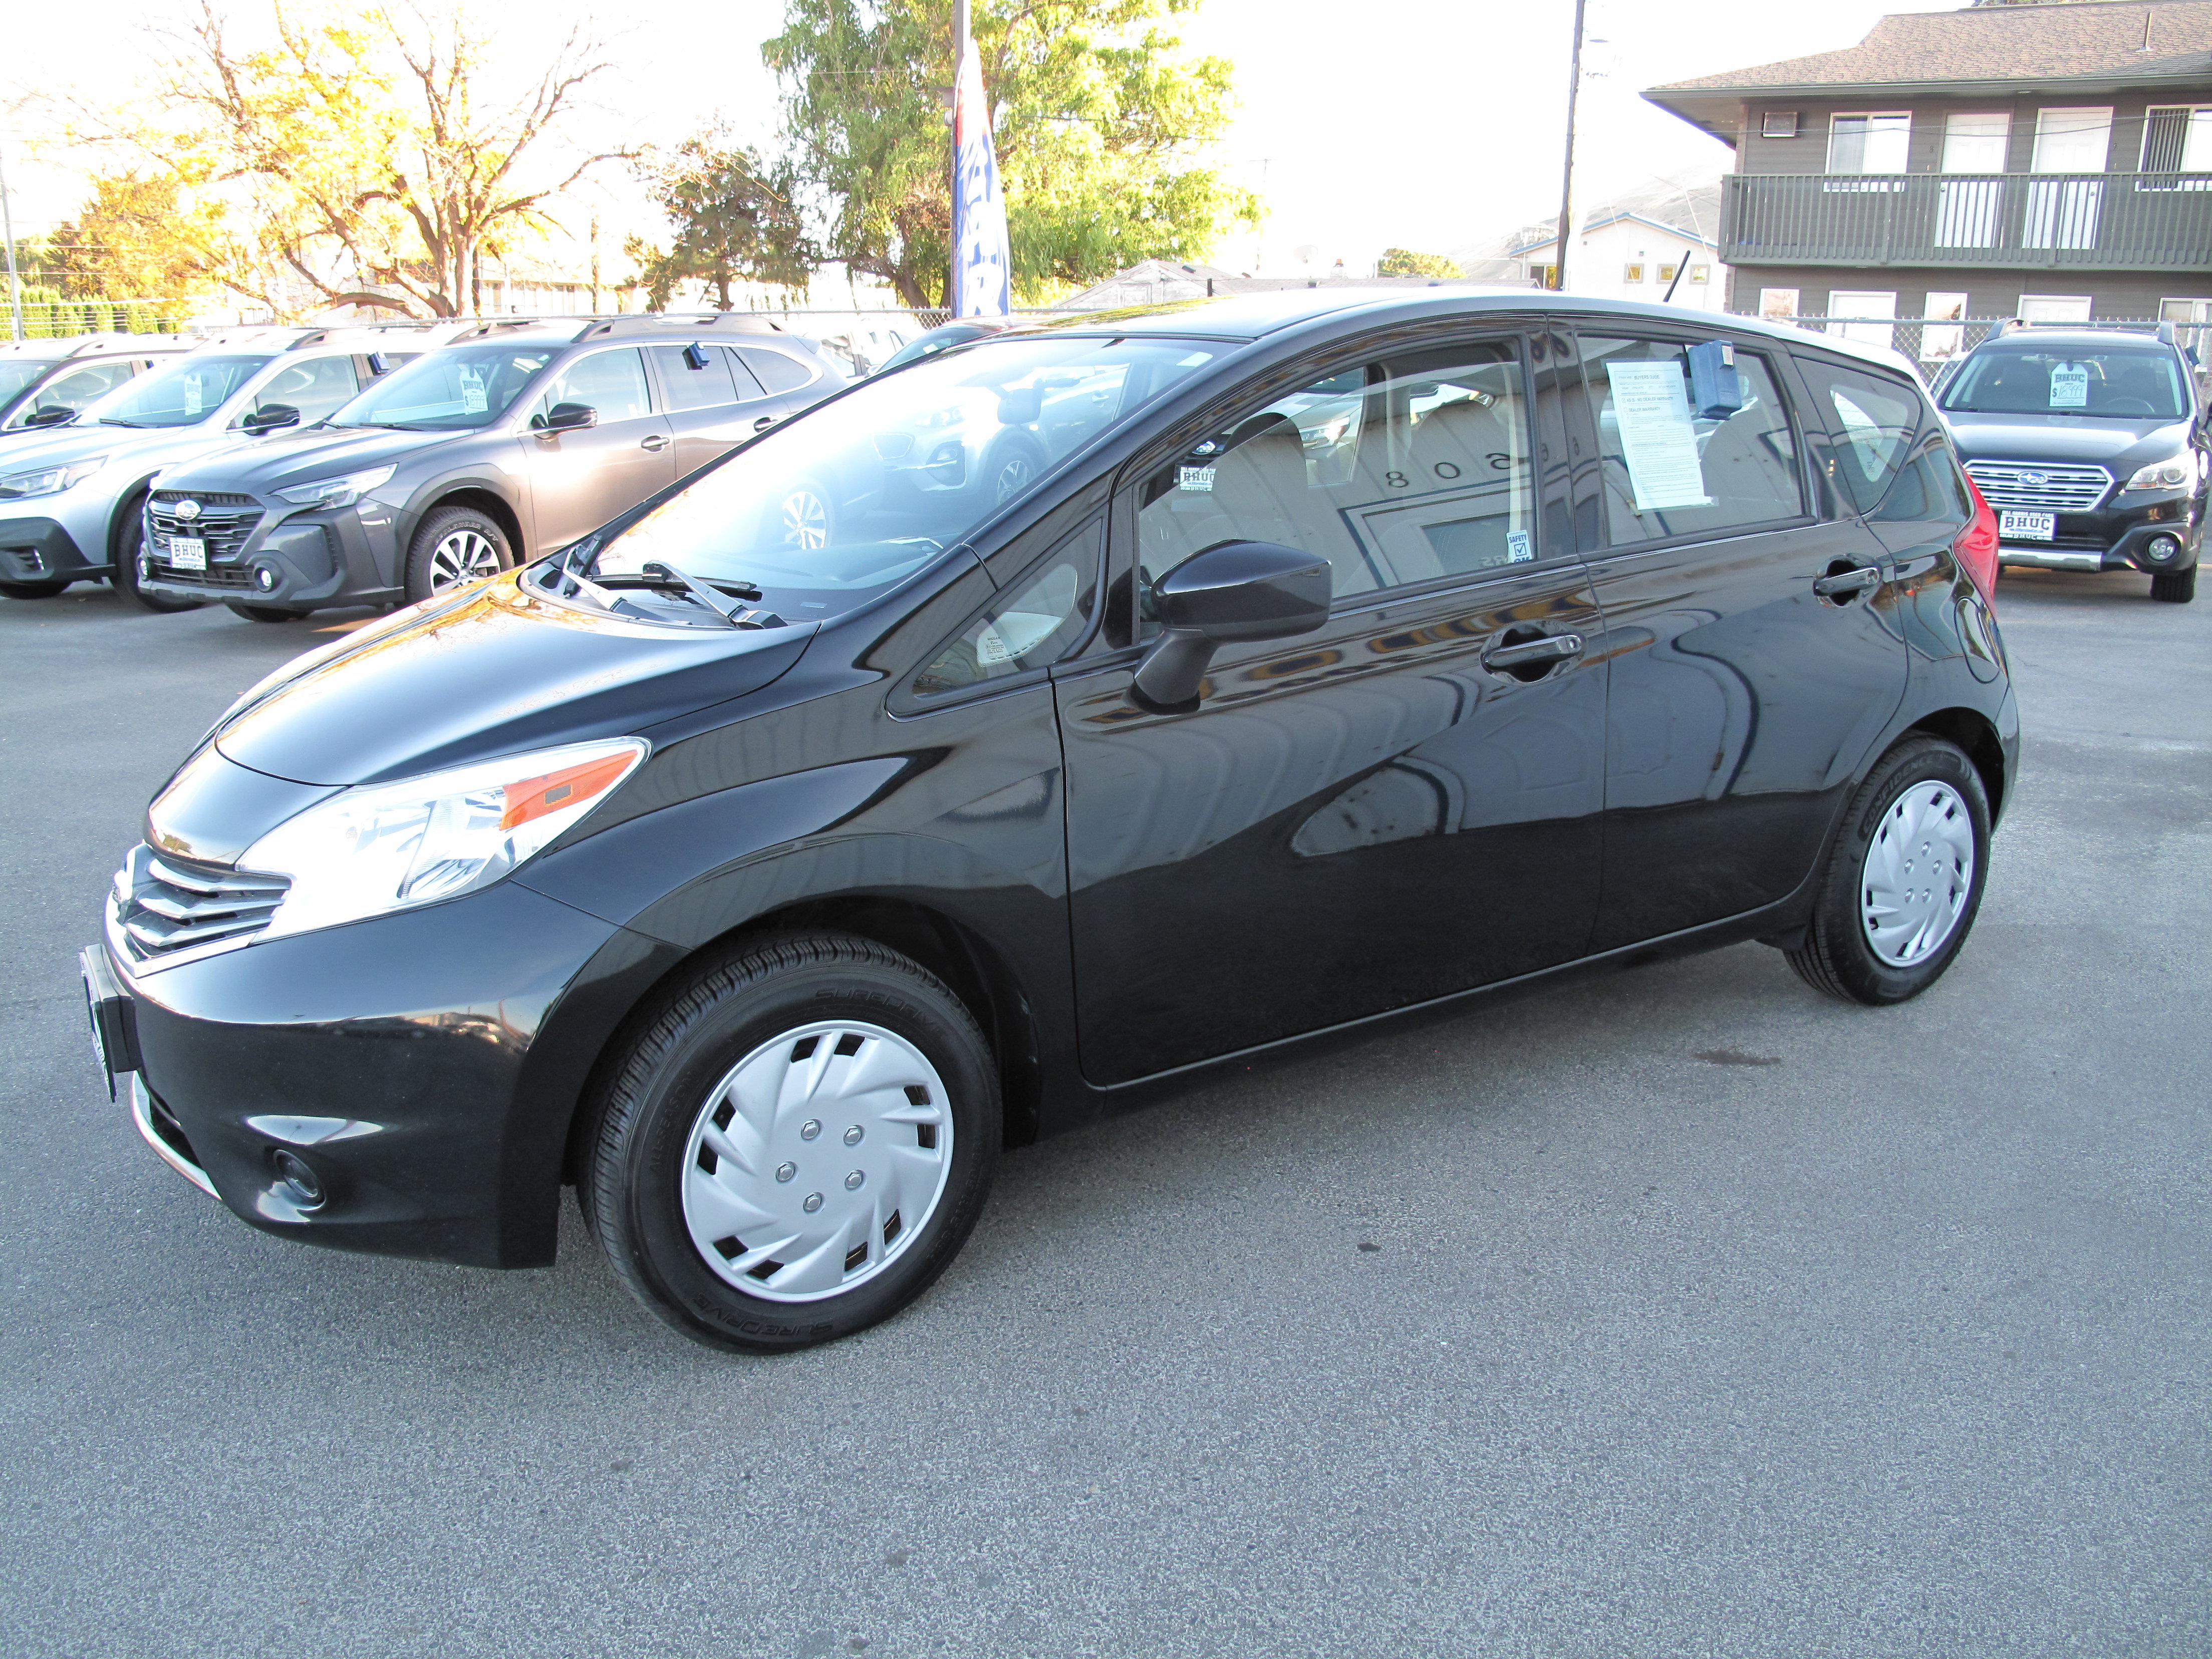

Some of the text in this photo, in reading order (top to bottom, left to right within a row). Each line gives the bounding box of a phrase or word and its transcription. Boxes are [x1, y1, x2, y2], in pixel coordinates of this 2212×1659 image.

[2054, 374, 2085, 383] BHUC
[2004, 516, 2050, 530] BHUC
[1509, 533, 1527, 543] SAFETY
[174, 544, 203, 559] BHUC
